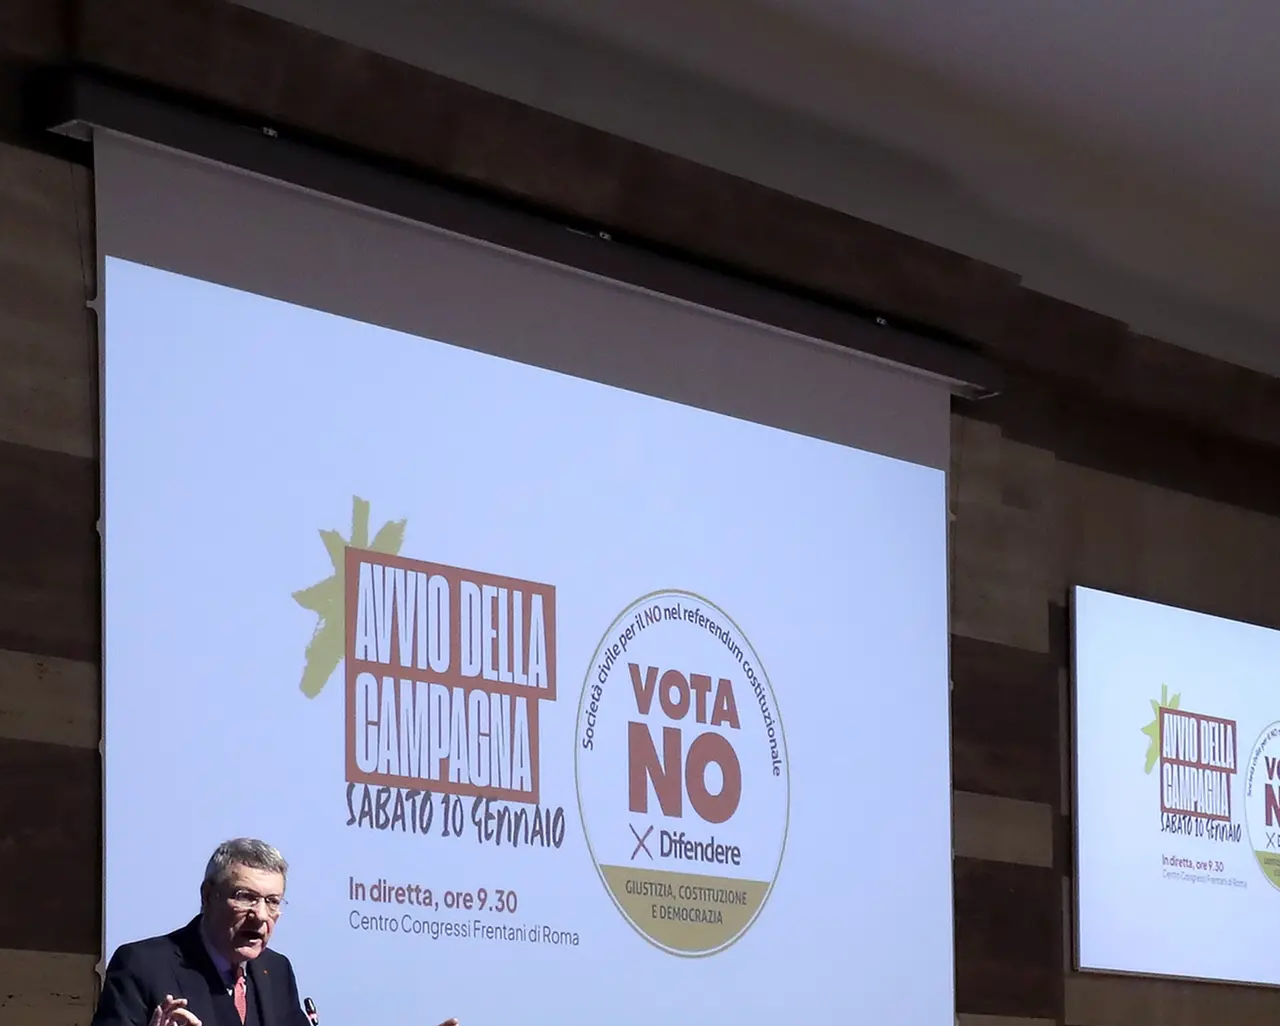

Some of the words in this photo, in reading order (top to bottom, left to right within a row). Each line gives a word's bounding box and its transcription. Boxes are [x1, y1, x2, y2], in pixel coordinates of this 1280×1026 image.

[355, 561, 450, 674] AVVIO
[460, 580, 548, 688] DELLA
[583, 684, 602, 751] Società
[598, 643, 621, 684] civile
[619, 624, 636, 652] per
[634, 613, 646, 631] il
[644, 605, 661, 626] NO
[664, 603, 682, 620] nel
[683, 608, 743, 663] referendum
[742, 661, 782, 776] costituzionale
[628, 663, 741, 729] VOTA
[355, 672, 532, 792] CAMPAGNA
[1163, 713, 1198, 763] AVVIO
[1200, 719, 1235, 769] DELLA
[628, 721, 741, 824] NO
[1163, 762, 1229, 817] CAMPAGNA
[346, 782, 433, 835] SABATO
[441, 793, 464, 837] 10
[1161, 812, 1192, 835] SABATO
[1195, 817, 1204, 837] 10
[660, 830, 741, 865] Difendere
[349, 876, 366, 901] In
[369, 879, 439, 911] diretta,
[444, 889, 473, 910] ore
[477, 887, 517, 913] 9.30
[625, 880, 676, 900] GIUSTIZIA,
[678, 885, 747, 905] COSTITUZIONE
[651, 904, 657, 918] E
[660, 905, 723, 924] DEMOCRAZIA
[349, 910, 398, 933] Centro
[401, 914, 470, 939] Congressi
[474, 920, 526, 941] Frentani
[529, 926, 540, 942] di
[543, 926, 579, 946] Roma
